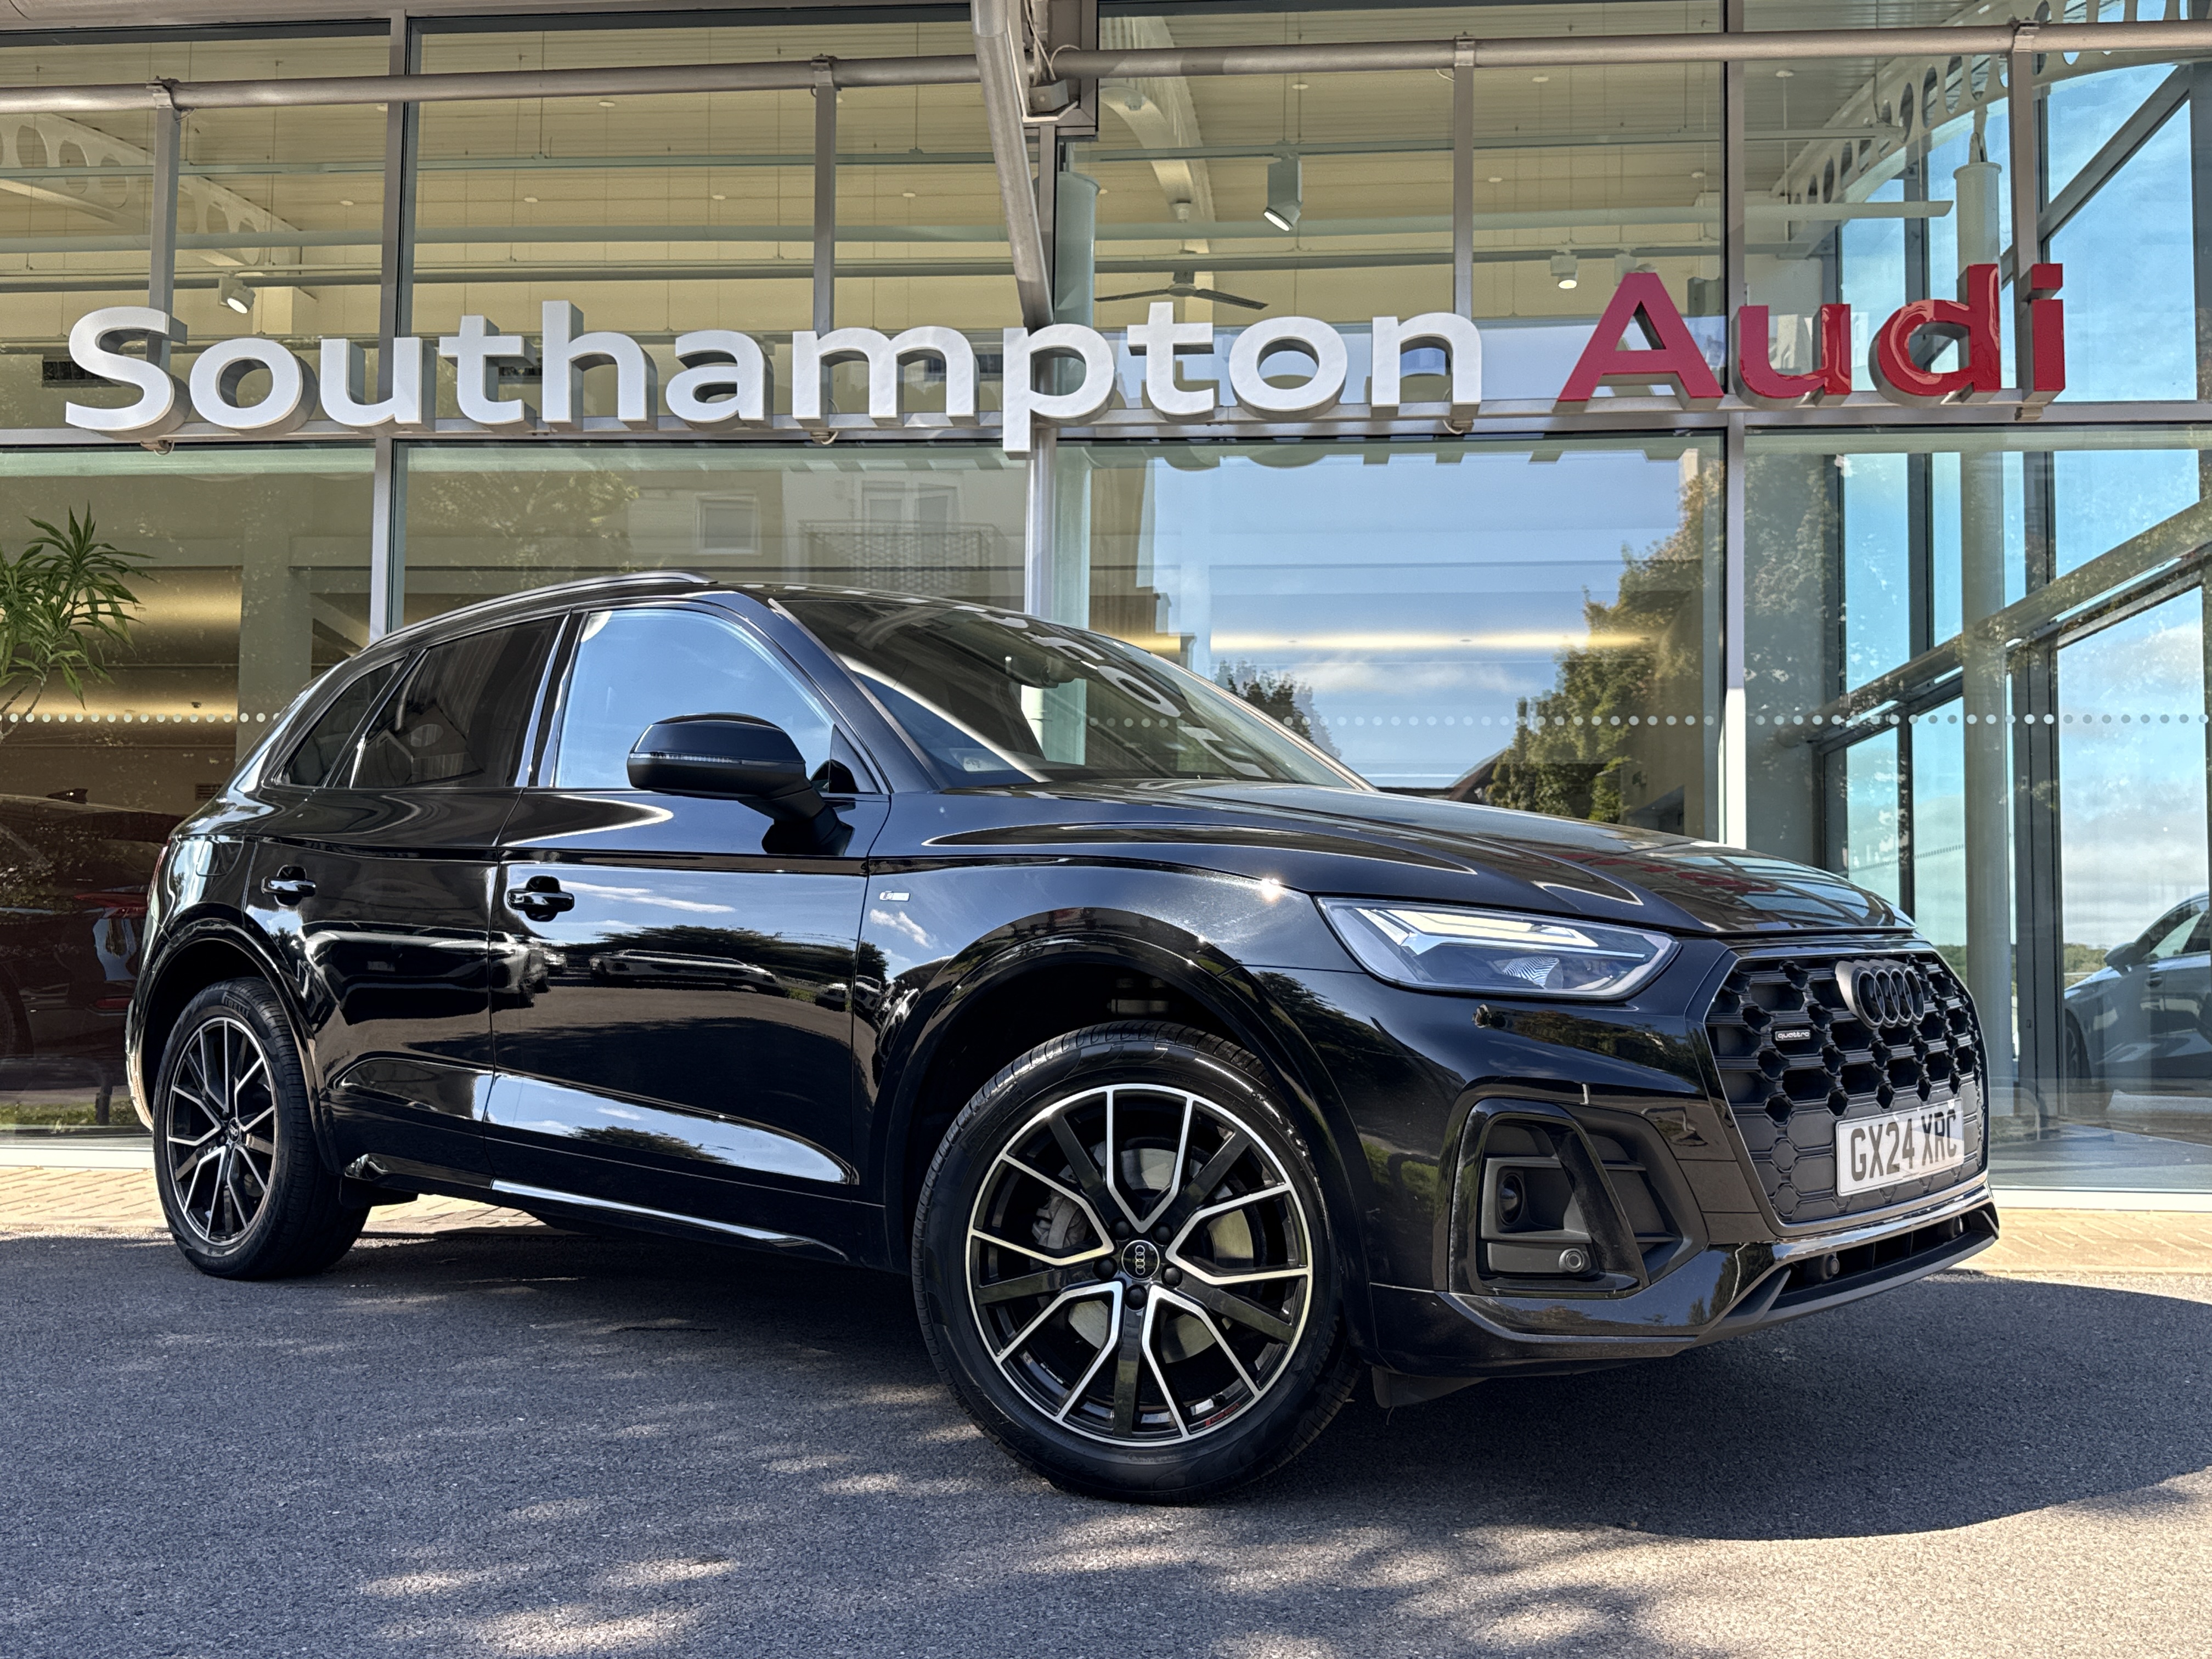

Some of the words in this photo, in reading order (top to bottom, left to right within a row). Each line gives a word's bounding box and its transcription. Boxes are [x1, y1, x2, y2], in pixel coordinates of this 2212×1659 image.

[66, 300, 1482, 454] Southampton
[1557, 263, 2066, 403] Audi
[1778, 1031, 1810, 1040] quattro
[1850, 1118, 1915, 1181] GX24
[1921, 1109, 1957, 1166] XRC
